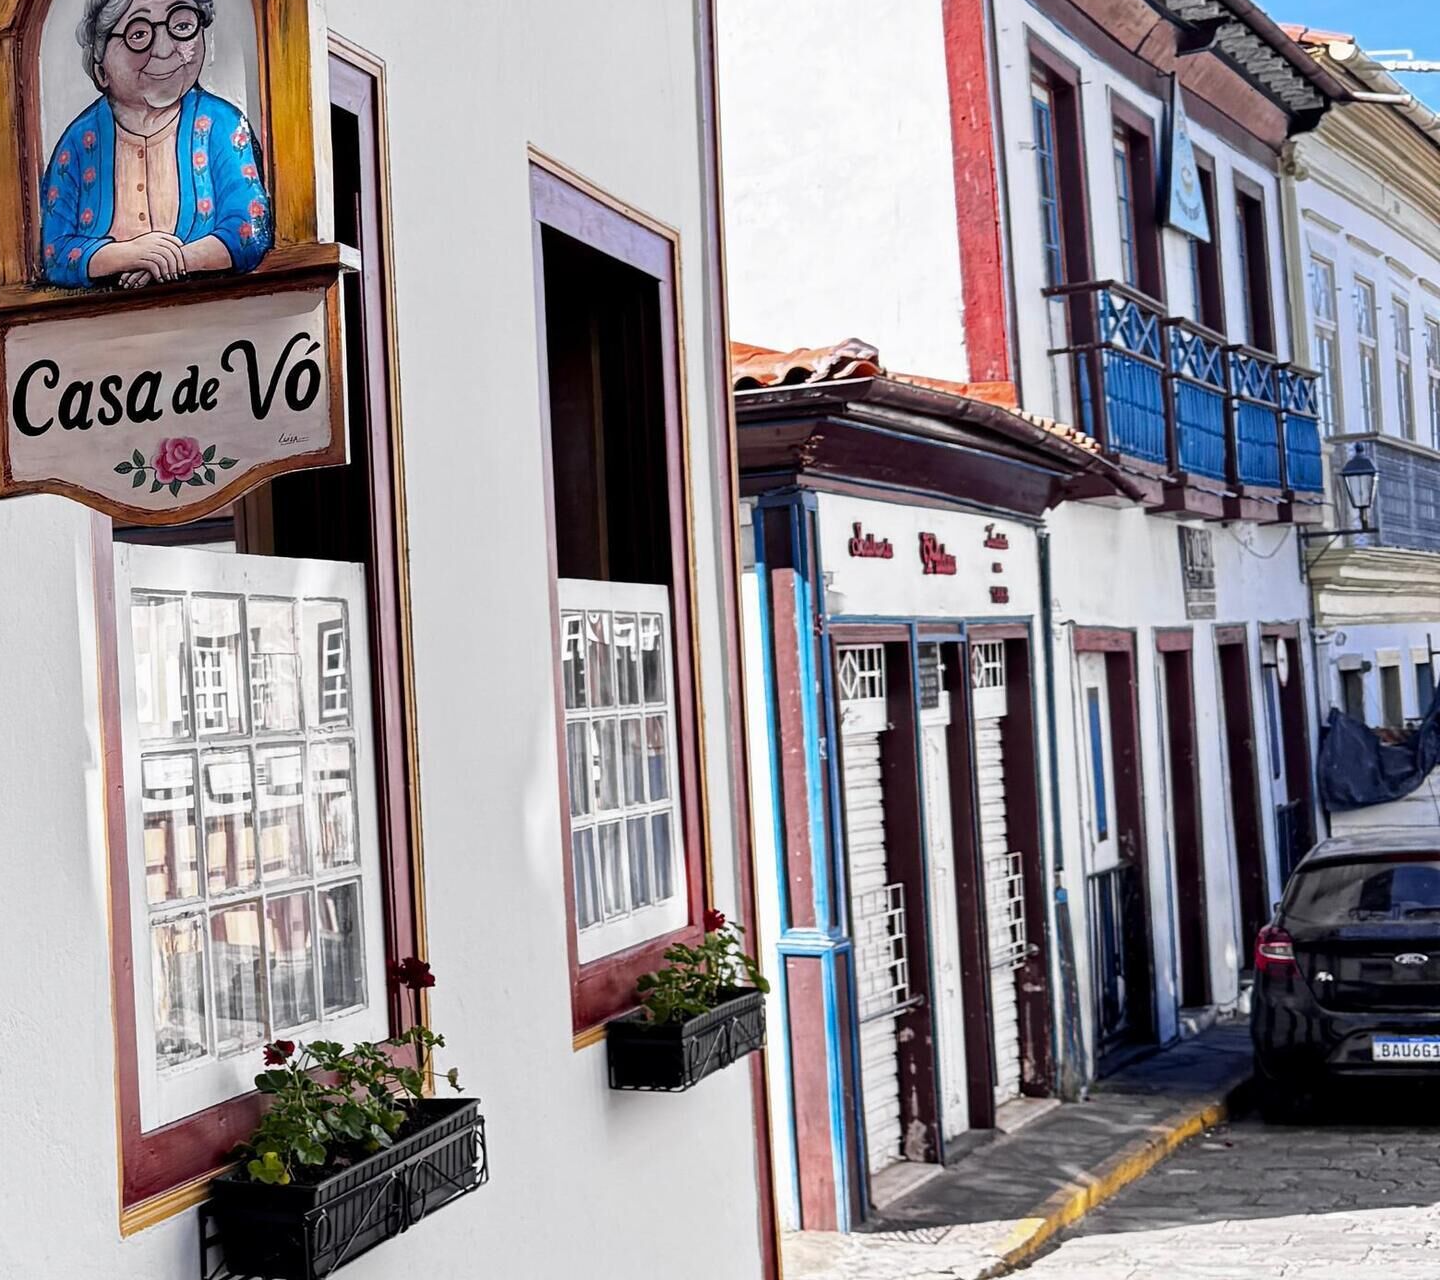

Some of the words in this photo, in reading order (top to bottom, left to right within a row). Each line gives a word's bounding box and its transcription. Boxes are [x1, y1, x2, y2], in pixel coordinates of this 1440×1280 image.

[12, 359, 163, 437] Casa
[172, 365, 220, 415] de
[221, 331, 322, 421] Vó
